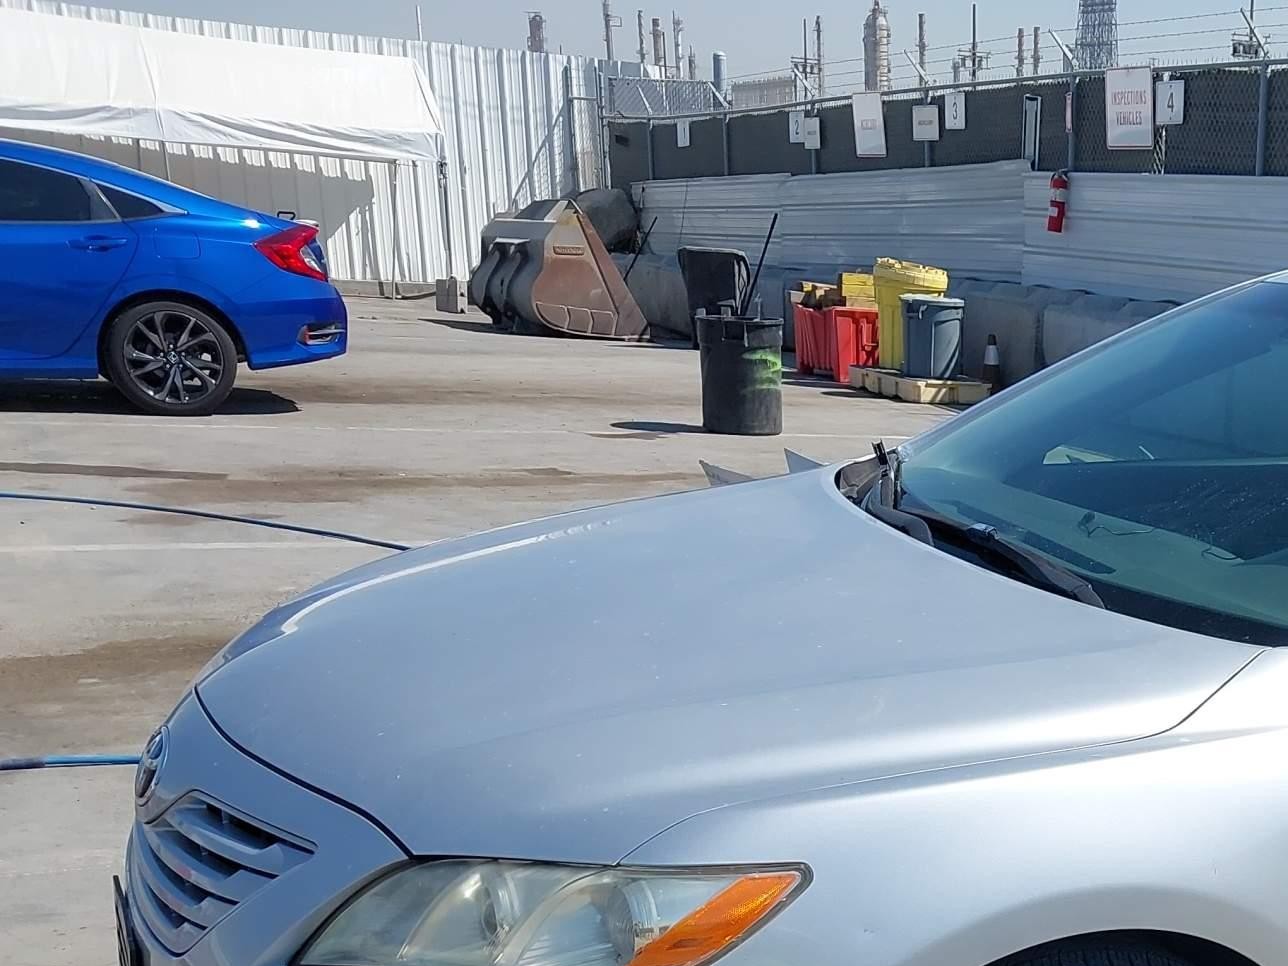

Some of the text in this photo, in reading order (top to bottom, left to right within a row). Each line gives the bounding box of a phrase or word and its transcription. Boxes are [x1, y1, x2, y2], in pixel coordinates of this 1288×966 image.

[1111, 89, 1147, 105] INSPECTIONS
[1166, 91, 1175, 113] 4
[952, 101, 959, 120] 3
[1115, 111, 1142, 126] VEHICLES
[794, 119, 800, 136] 2
